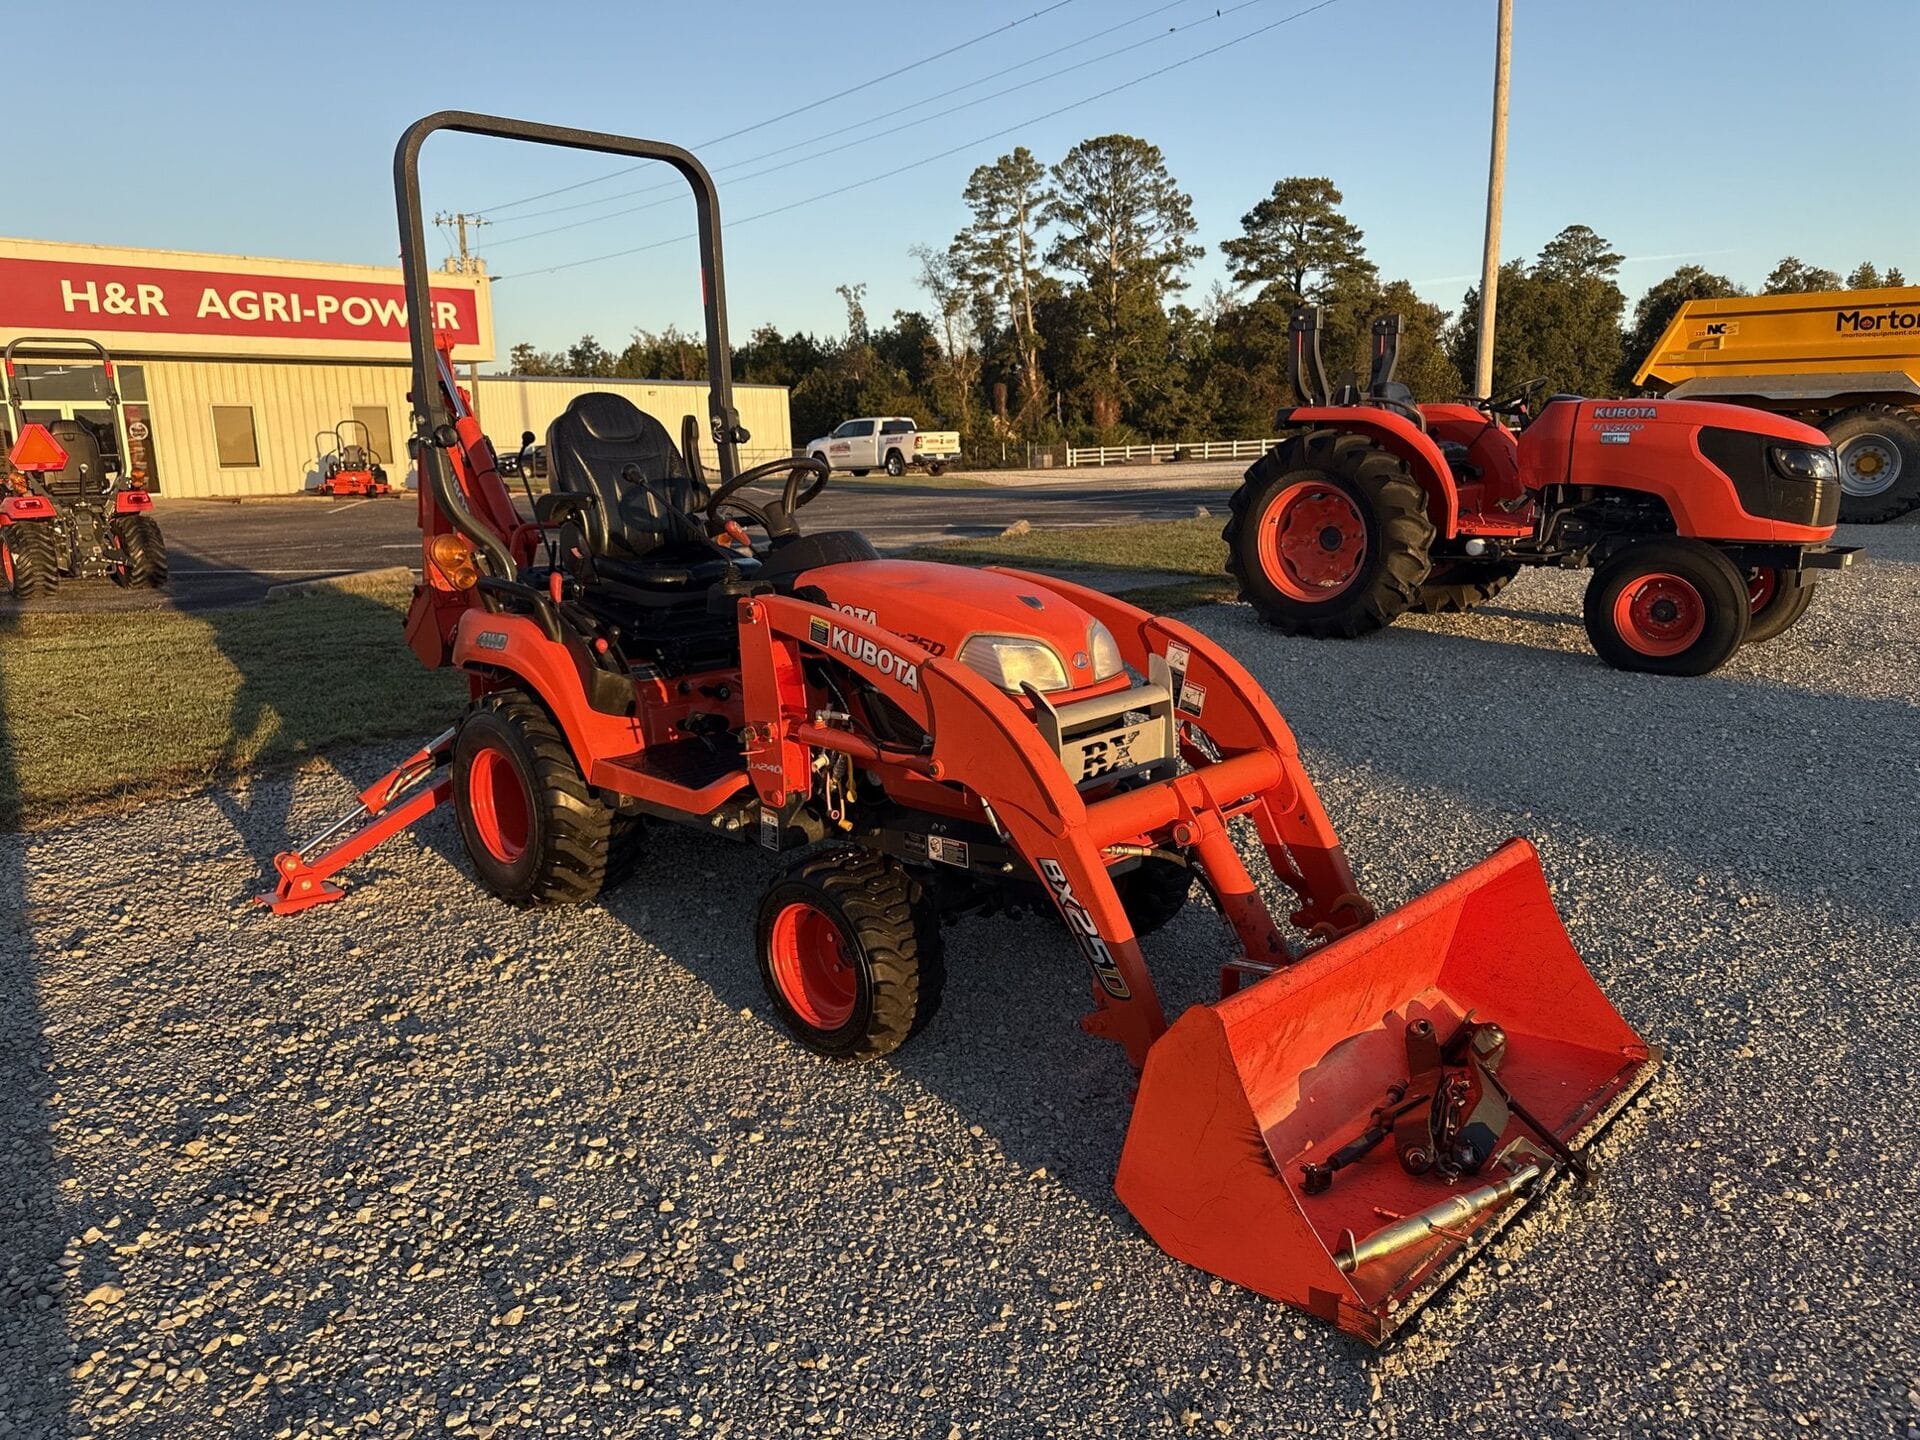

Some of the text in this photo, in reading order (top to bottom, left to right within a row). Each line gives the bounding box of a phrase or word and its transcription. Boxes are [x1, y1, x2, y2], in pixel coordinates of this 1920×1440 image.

[60, 279, 461, 330] H&R AGRI-POWR
[1594, 407, 1657, 418] KUBOTA
[832, 624, 919, 692] KUBOTA
[1037, 857, 1132, 1000] BX25D
